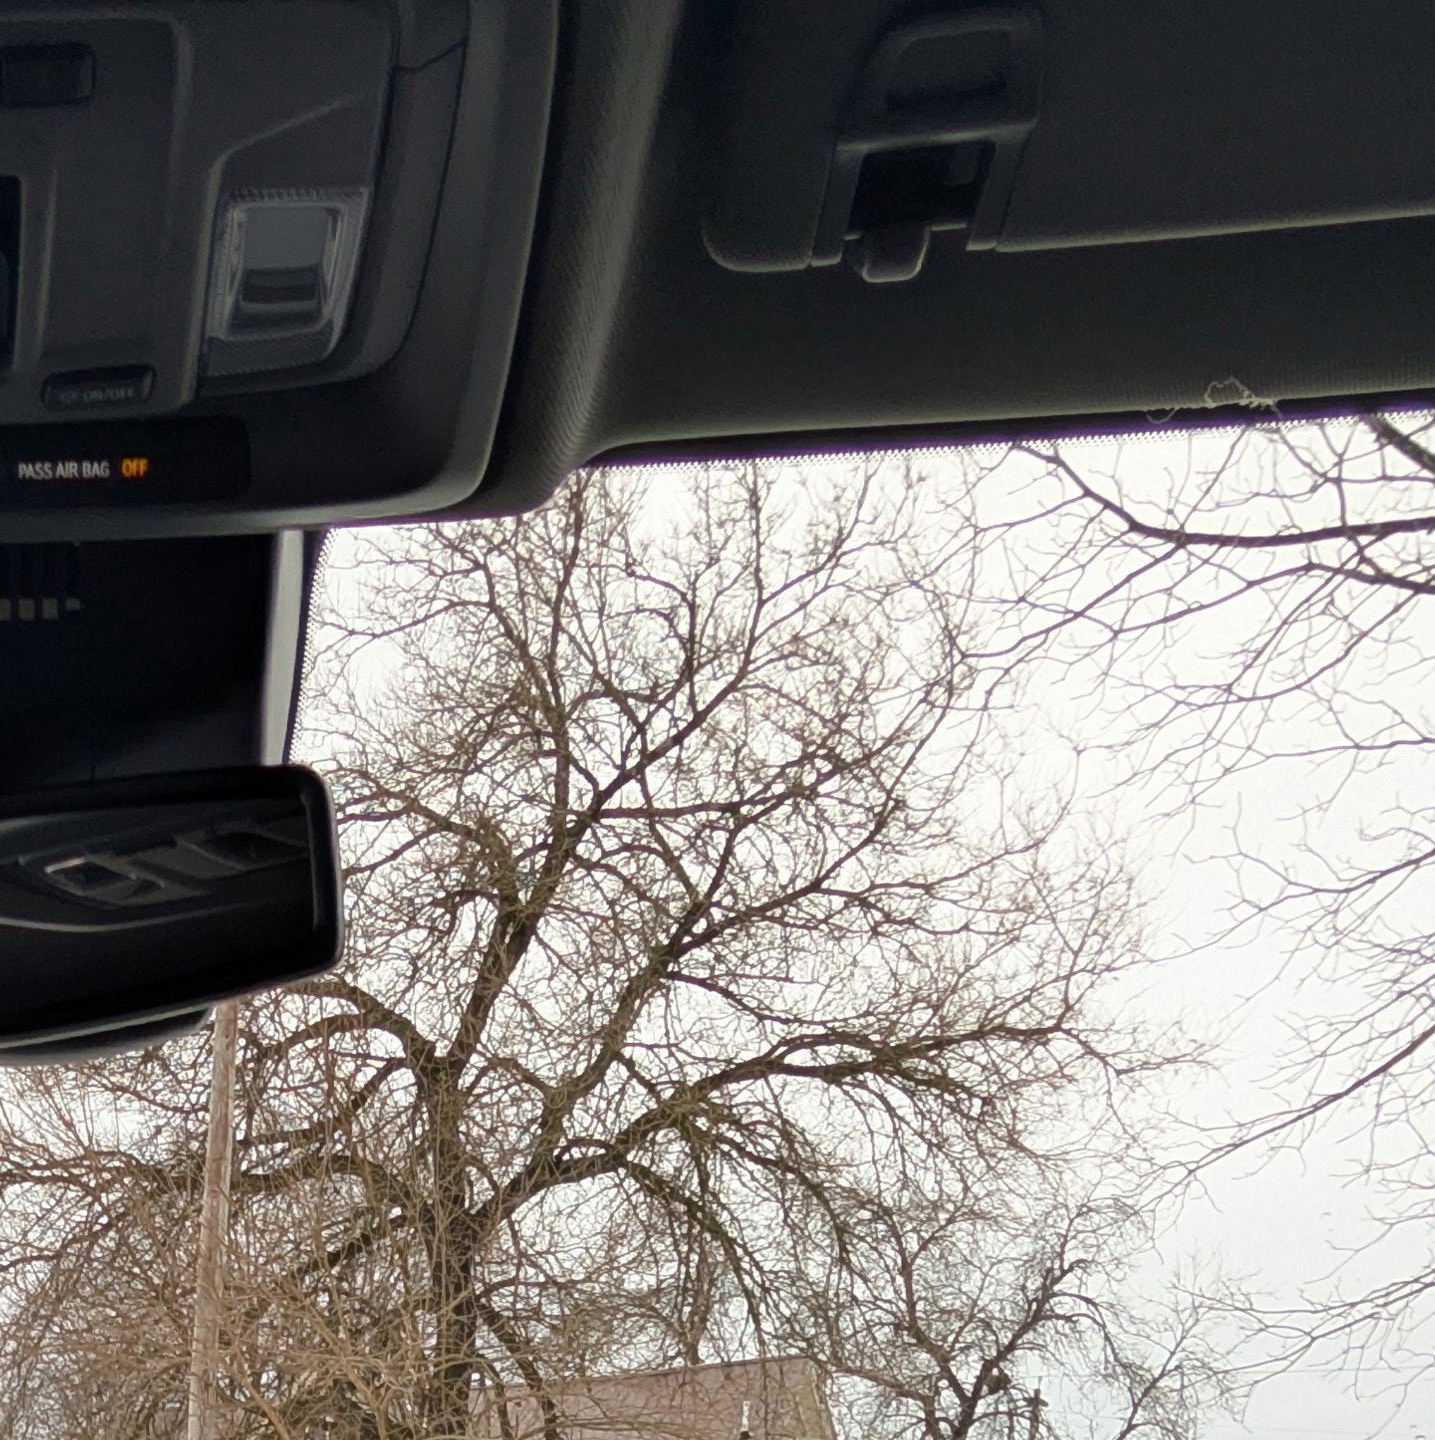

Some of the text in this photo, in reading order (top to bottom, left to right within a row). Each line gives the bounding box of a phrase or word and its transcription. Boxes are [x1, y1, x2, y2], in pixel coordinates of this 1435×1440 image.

[18, 458, 150, 480] PASS AIR BAG OFF
